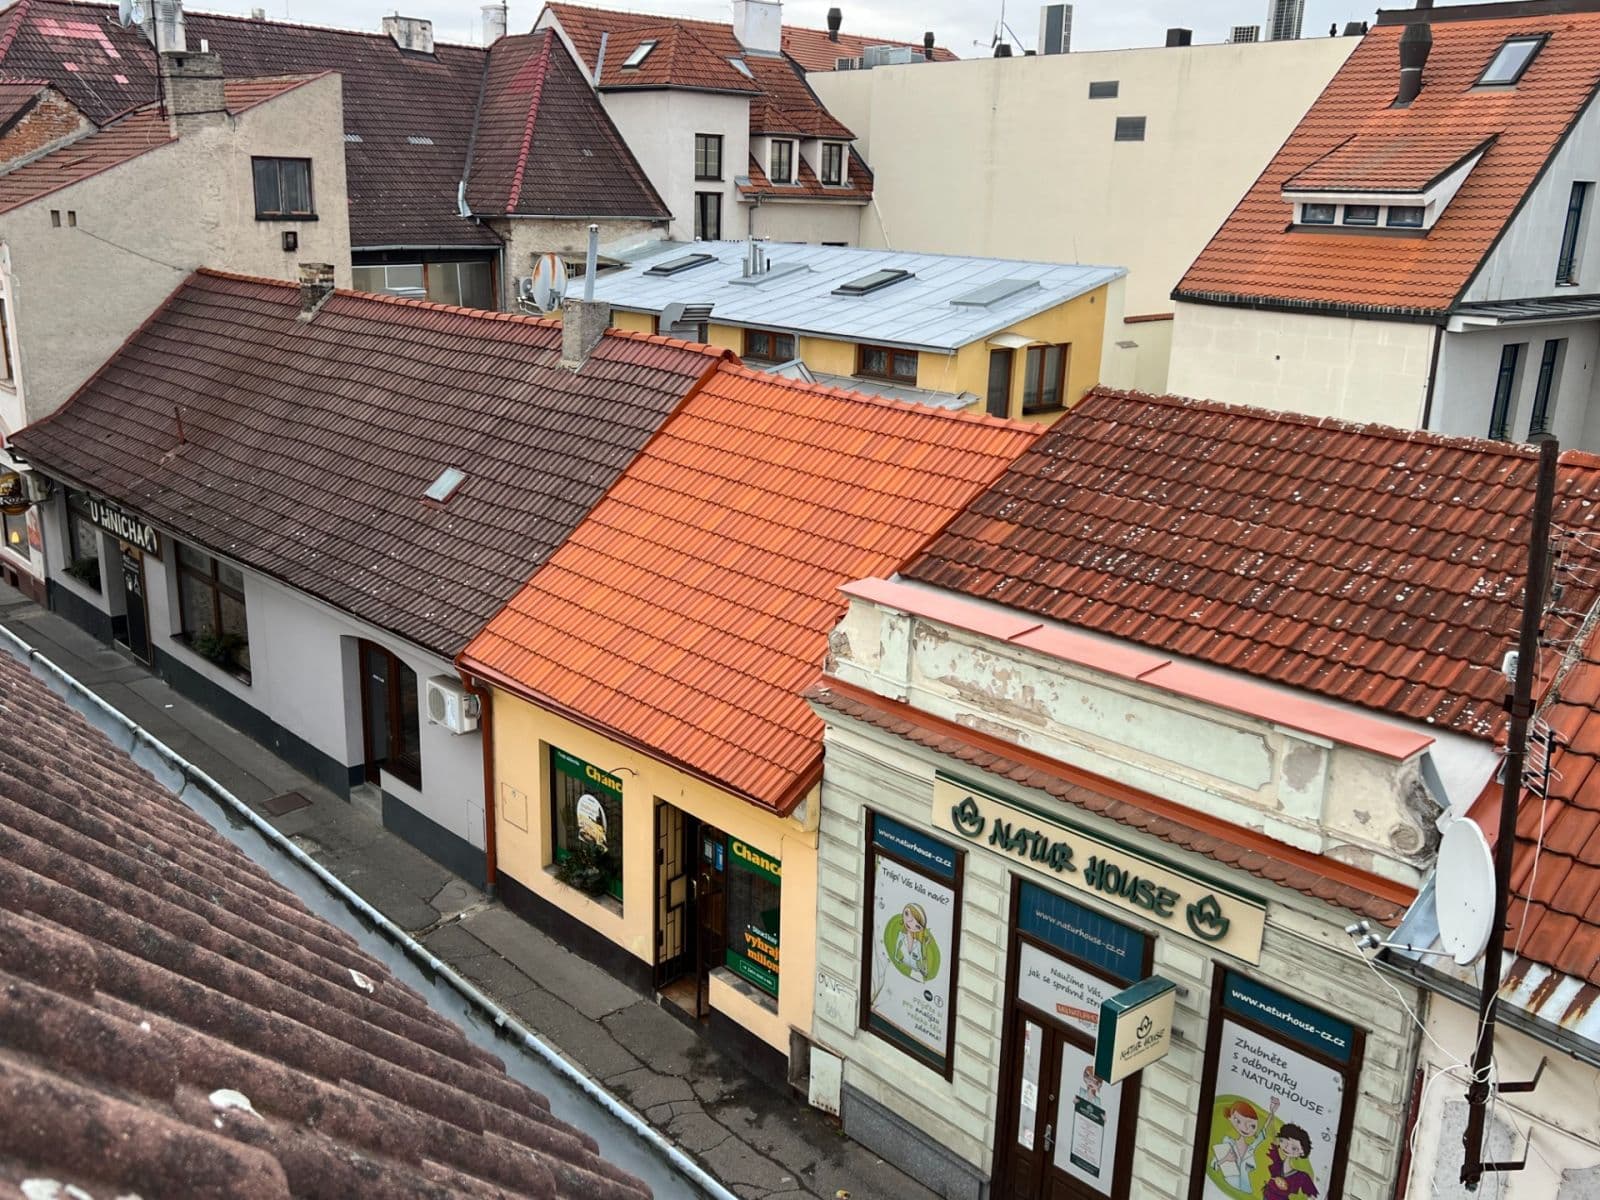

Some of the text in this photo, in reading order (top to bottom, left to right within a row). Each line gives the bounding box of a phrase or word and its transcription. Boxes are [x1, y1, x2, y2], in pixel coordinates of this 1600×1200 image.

[90, 500, 146, 548] U MNICHA
[878, 828, 952, 868] www.naturhouse-cz.cz
[989, 818, 1180, 918] NATUR HOUSE
[901, 875, 913, 889] Vás
[744, 931, 780, 961] vyhraj
[1035, 909, 1126, 958] www.naturhouse-cz.cz
[1028, 966, 1041, 978] jak
[1042, 975, 1052, 985] se
[1053, 979, 1085, 1001] správně
[1051, 967, 1104, 1000] Naučíme Vás,
[1232, 989, 1346, 1048] www.naturhouse-cz.cz
[1233, 1051, 1298, 1091] s odborníky
[1235, 1038, 1288, 1070] Zhubněte
[1231, 1064, 1325, 1116] z NATURHOUSE
